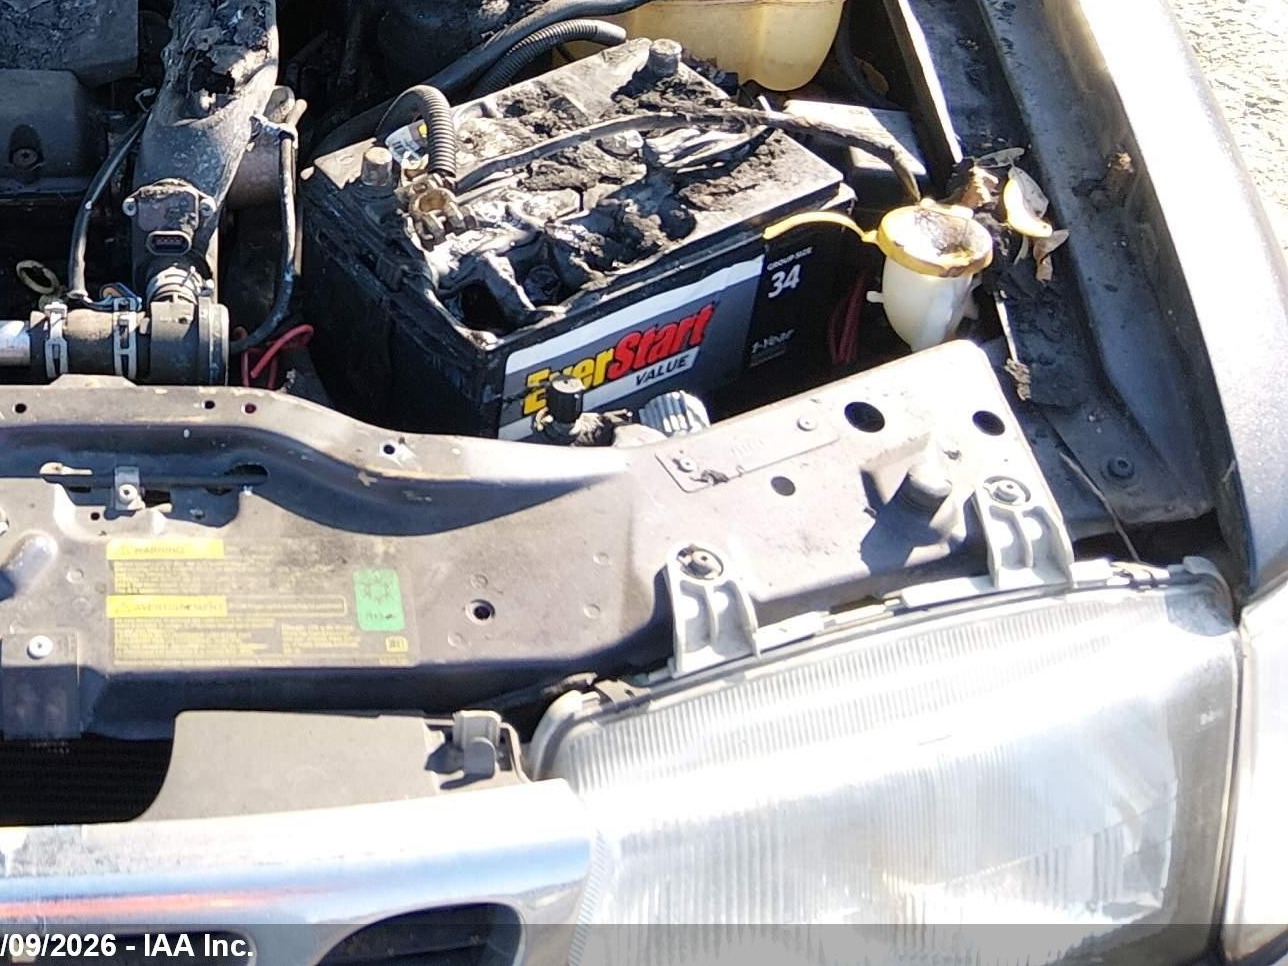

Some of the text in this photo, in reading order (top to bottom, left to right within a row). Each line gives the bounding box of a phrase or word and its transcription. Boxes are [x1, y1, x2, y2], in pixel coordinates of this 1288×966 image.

[767, 264, 801, 299] 34
[523, 303, 715, 416] EerStart
[634, 353, 691, 386] VALUE
